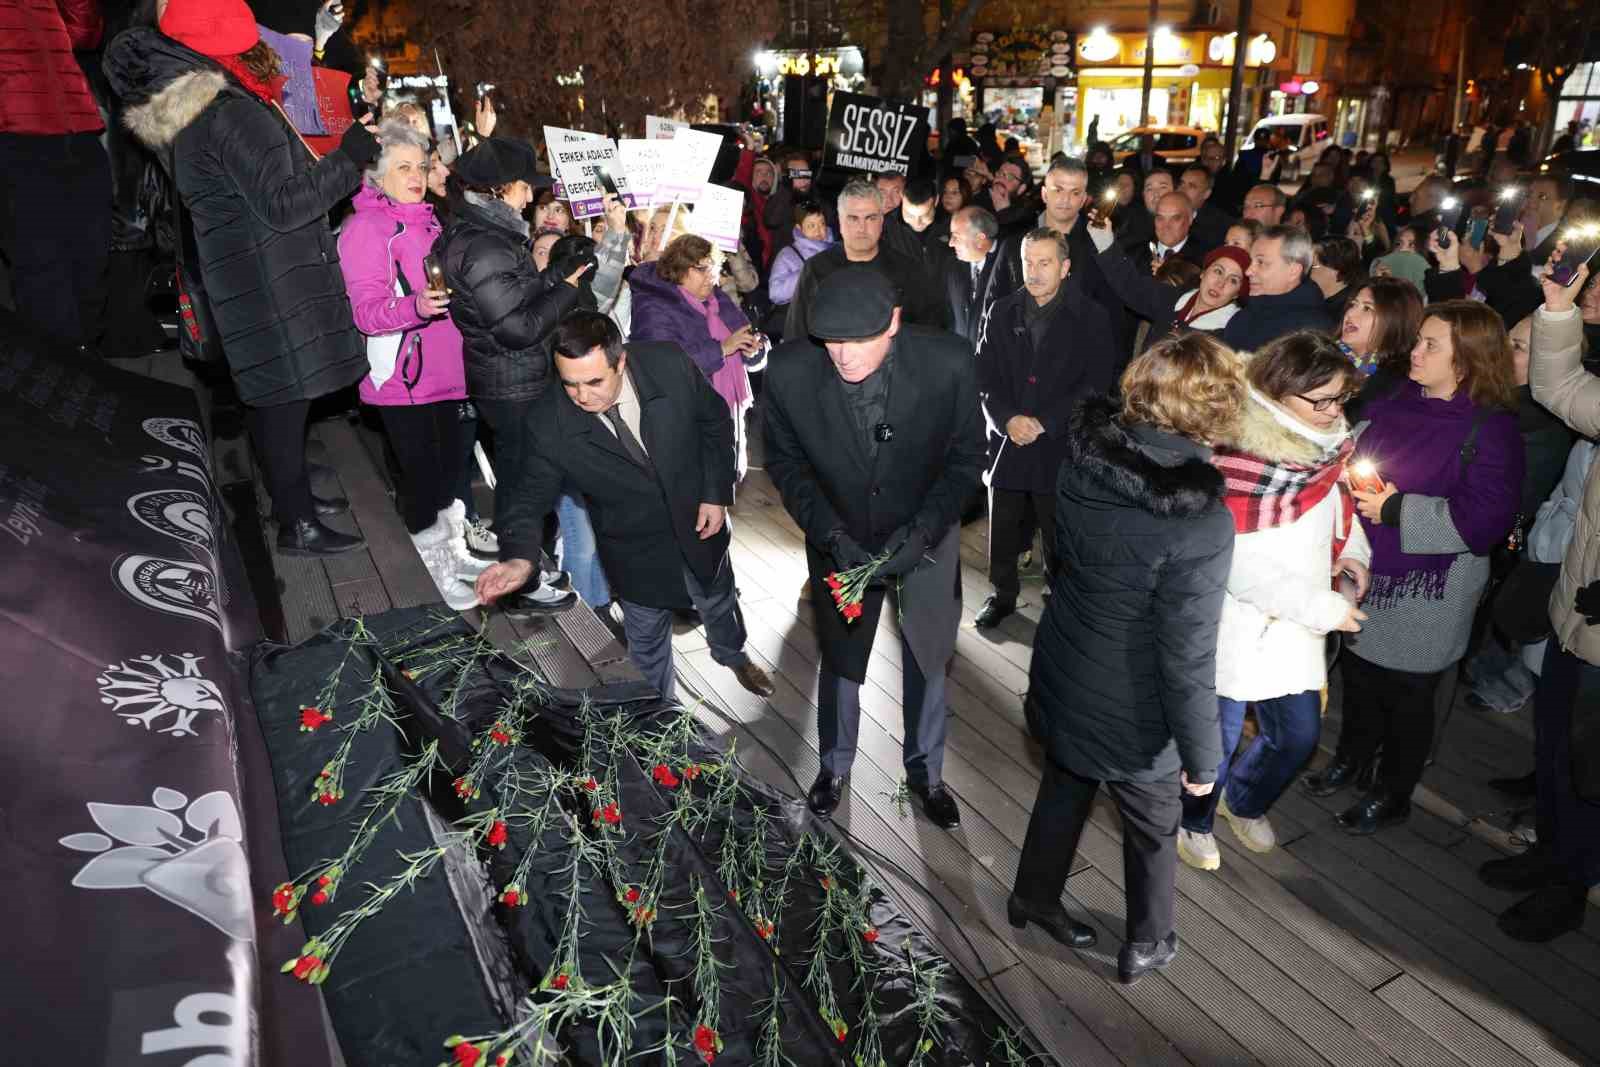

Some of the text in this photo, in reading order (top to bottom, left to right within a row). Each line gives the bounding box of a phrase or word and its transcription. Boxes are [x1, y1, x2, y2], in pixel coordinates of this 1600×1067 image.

[840, 103, 918, 161] SESSİZ
[559, 147, 615, 163] ERKEK ADALET
